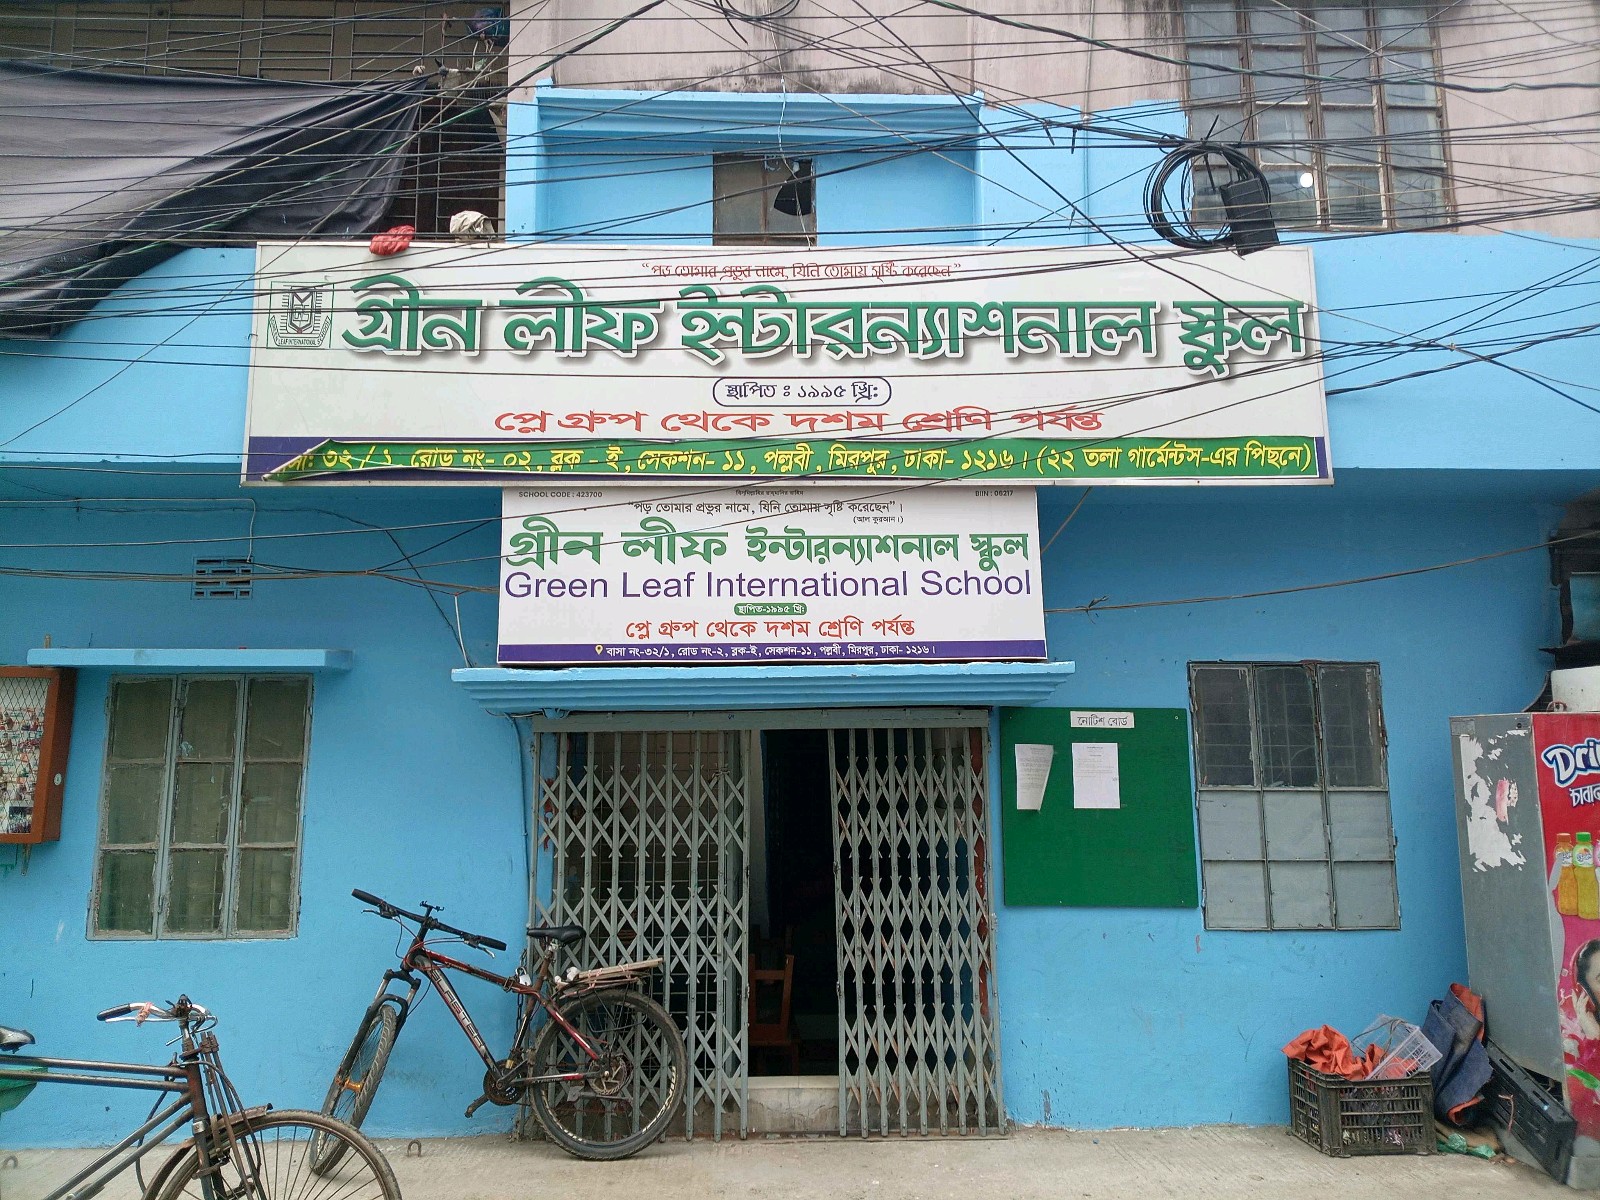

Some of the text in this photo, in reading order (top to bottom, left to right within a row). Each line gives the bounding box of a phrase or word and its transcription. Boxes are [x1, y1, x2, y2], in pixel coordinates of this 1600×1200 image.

[341, 273, 1304, 375] গ্রীন লীফ ইন্টারন্যাশনাল স্কুল
[725, 381, 777, 399] স্থাপিত
[797, 384, 847, 398] ১৯৯৫
[494, 404, 1104, 434] প্লে গ্রুপ থেকে দশম শ্রেণি পর্যন্ত
[1083, 447, 1122, 469] তলা
[656, 502, 693, 513] তোমার
[695, 502, 722, 516] প্রভুর
[725, 501, 755, 515] নামে,
[758, 500, 781, 513] যিনি
[824, 500, 844, 516] সৃষ্টি
[505, 516, 1029, 575] গ্রীন লীফ ইন্টারন্যাশনাল স্কুল
[505, 569, 1031, 598] Green Leaf International School
[626, 614, 915, 640] প্লে গ্রুপ থেকে দশম শ্রেণি পর্যন্ত
[606, 646, 626, 657] বাসা
[677, 646, 698, 657] রোড
[1077, 713, 1129, 726] নোটিশ বোর্ড
[1542, 739, 1600, 785] Dri
